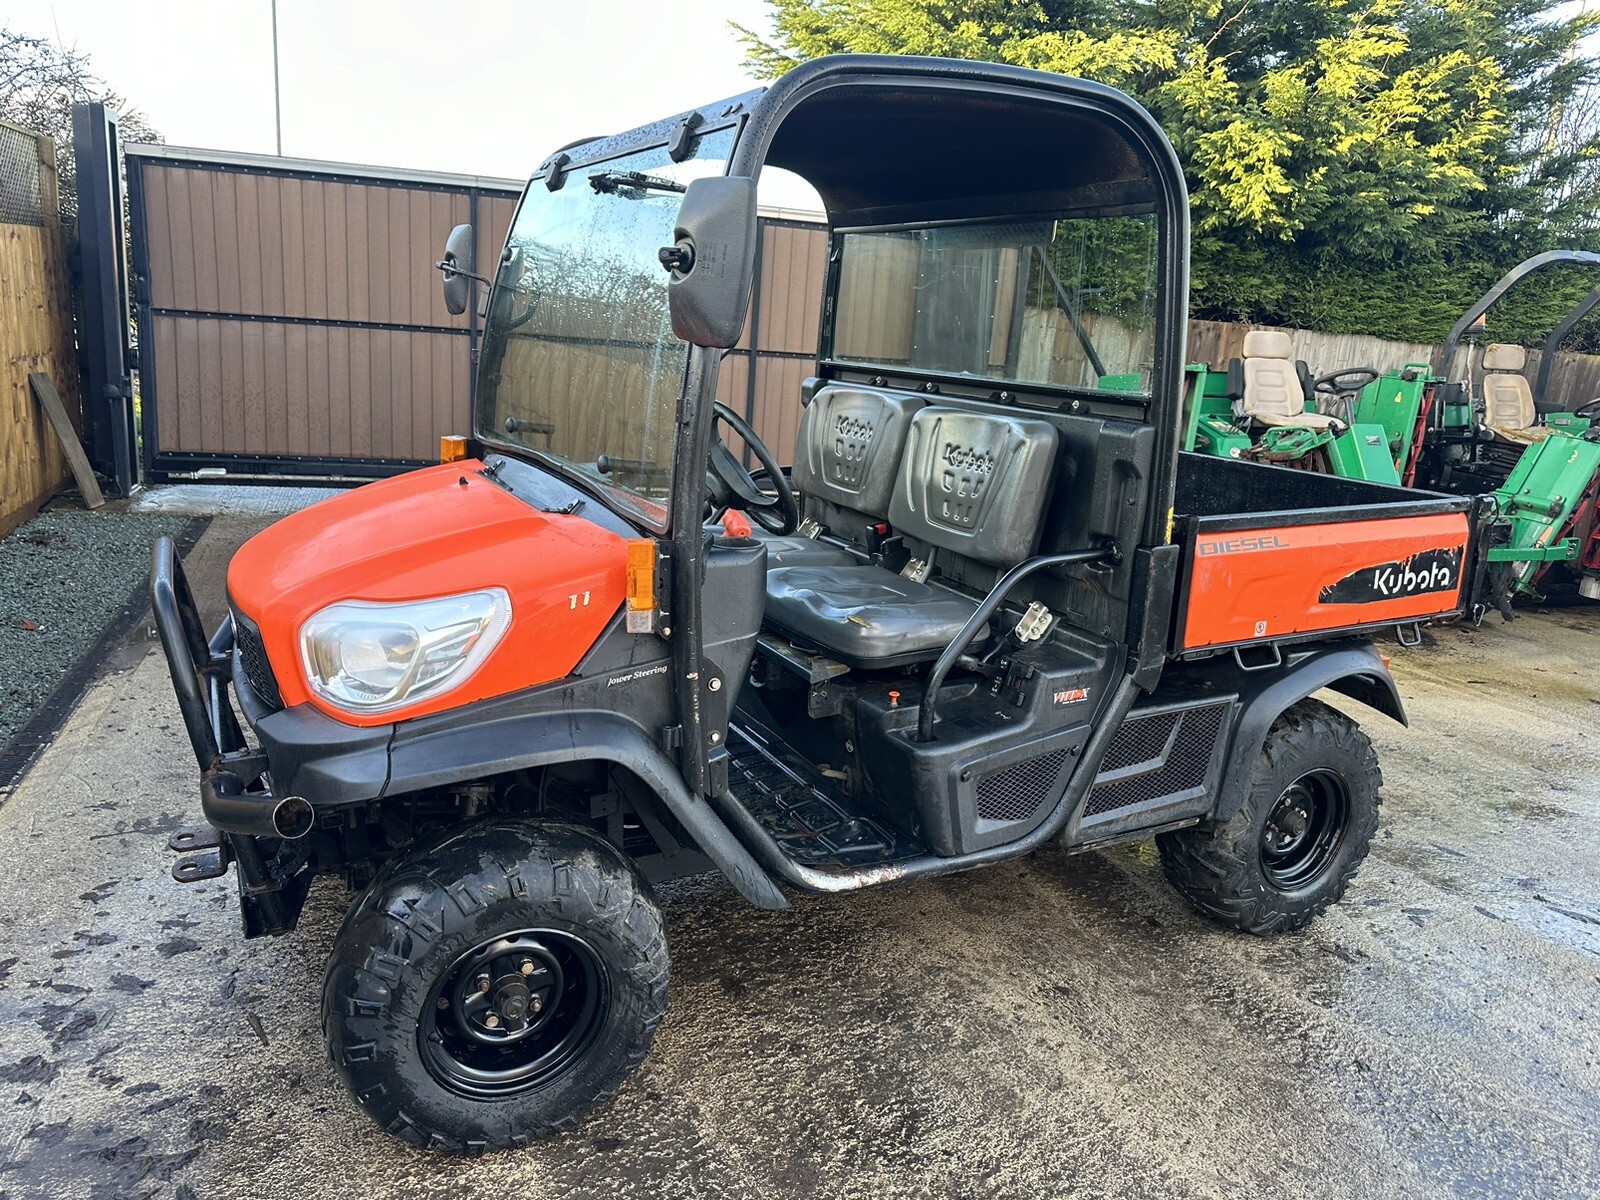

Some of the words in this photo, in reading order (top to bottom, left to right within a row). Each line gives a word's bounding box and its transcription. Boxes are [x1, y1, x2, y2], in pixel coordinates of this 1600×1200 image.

[836, 415, 873, 442] Kubota
[943, 443, 994, 475] Kubota
[1199, 536, 1290, 555] DIESEL
[1373, 562, 1451, 595] Kubota
[632, 665, 668, 679] Steering
